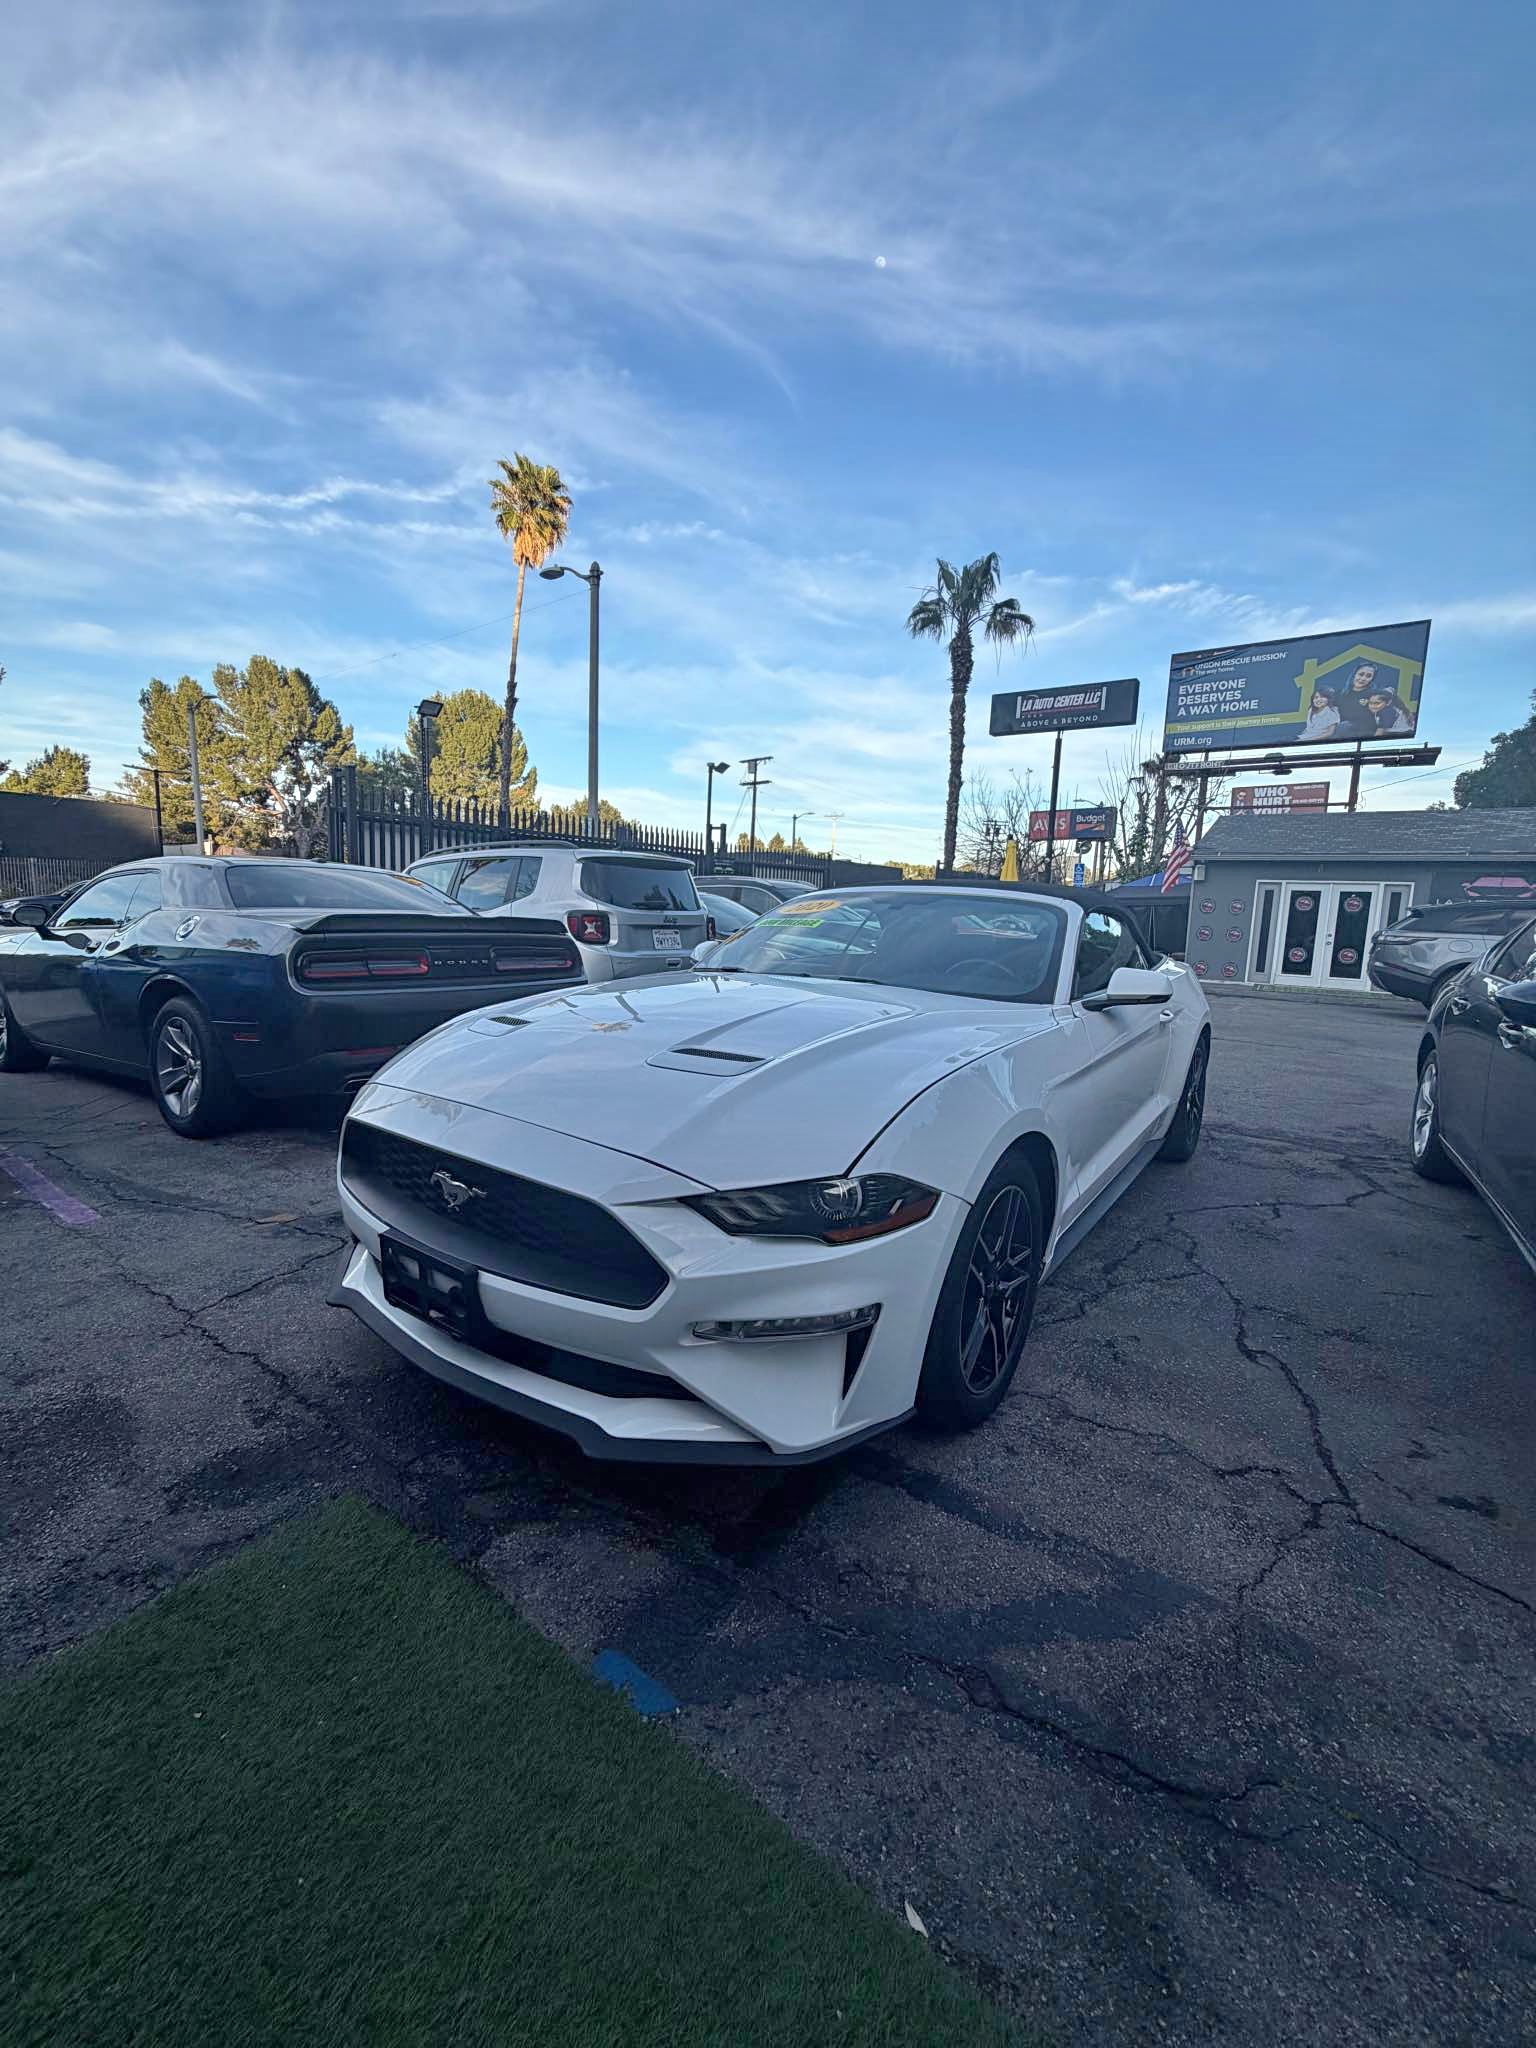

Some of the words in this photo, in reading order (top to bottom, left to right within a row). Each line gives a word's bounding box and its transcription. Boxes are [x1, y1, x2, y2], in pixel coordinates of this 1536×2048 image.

[1195, 661, 1220, 670] UNION
[1221, 657, 1250, 666] RESCUE
[1252, 652, 1286, 663] MISSION
[1179, 678, 1247, 695] EVERYONE
[1022, 699, 1032, 711] LA
[1033, 697, 1055, 710] AUTO
[1054, 693, 1084, 708] CENTER
[1084, 691, 1101, 705] LLC
[1178, 690, 1241, 706] DESERVES
[1177, 708, 1186, 717] A
[1190, 704, 1218, 715] WAY
[1220, 699, 1259, 712] HOME
[1021, 719, 1049, 728] ABOVE
[1061, 714, 1099, 725] BEYOND
[1191, 721, 1214, 731] support
[1174, 737, 1212, 746] URM.org
[1254, 786, 1288, 798] WHO
[1252, 796, 1292, 806] HURT
[1076, 814, 1106, 824] Budget
